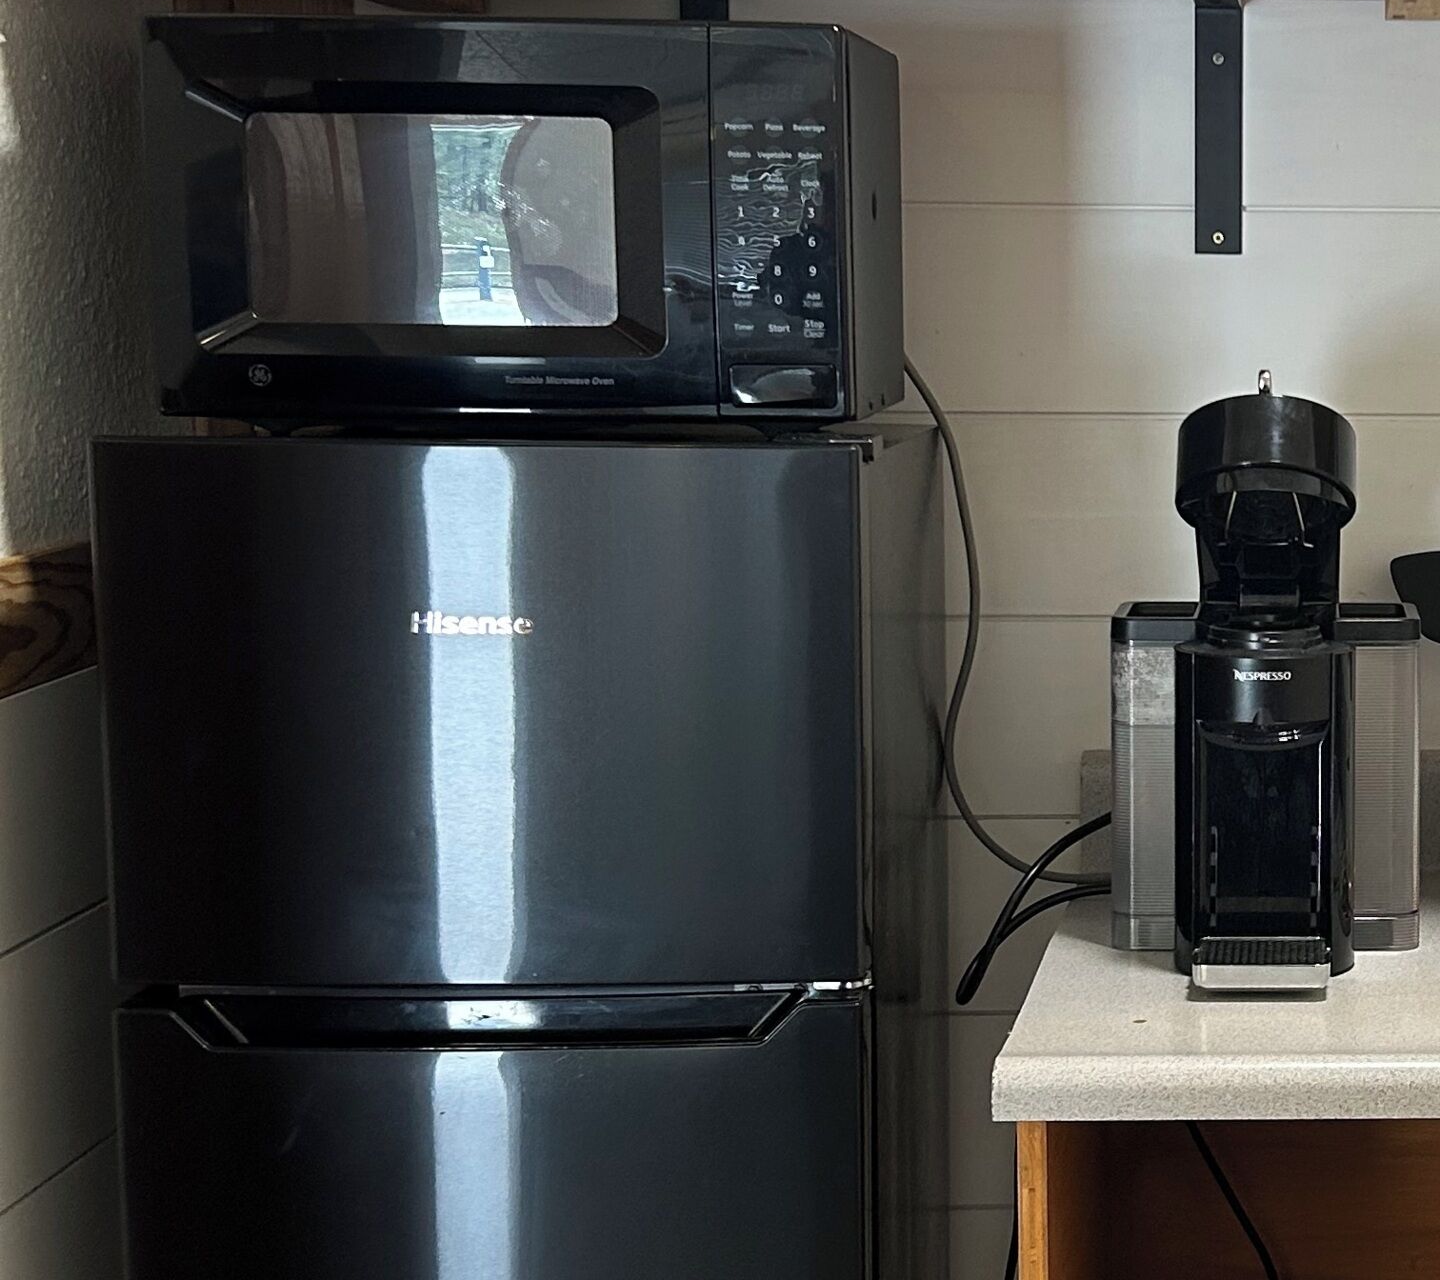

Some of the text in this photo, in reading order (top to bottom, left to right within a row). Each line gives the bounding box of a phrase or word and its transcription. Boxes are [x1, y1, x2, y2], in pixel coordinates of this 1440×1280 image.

[724, 122, 754, 132] Popcorn
[792, 123, 826, 133] Beverage
[756, 151, 793, 160] Vegetable
[737, 205, 745, 218] 1
[772, 206, 780, 218] 2
[807, 207, 815, 219] 3
[774, 235, 781, 247] 5
[808, 236, 816, 248] 6
[774, 265, 782, 277] 8
[808, 265, 817, 277] 9
[774, 294, 783, 306] 0
[768, 323, 791, 333] Start
[804, 319, 825, 329] Stop
[591, 376, 615, 386] Oven
[410, 610, 534, 635] Hisense
